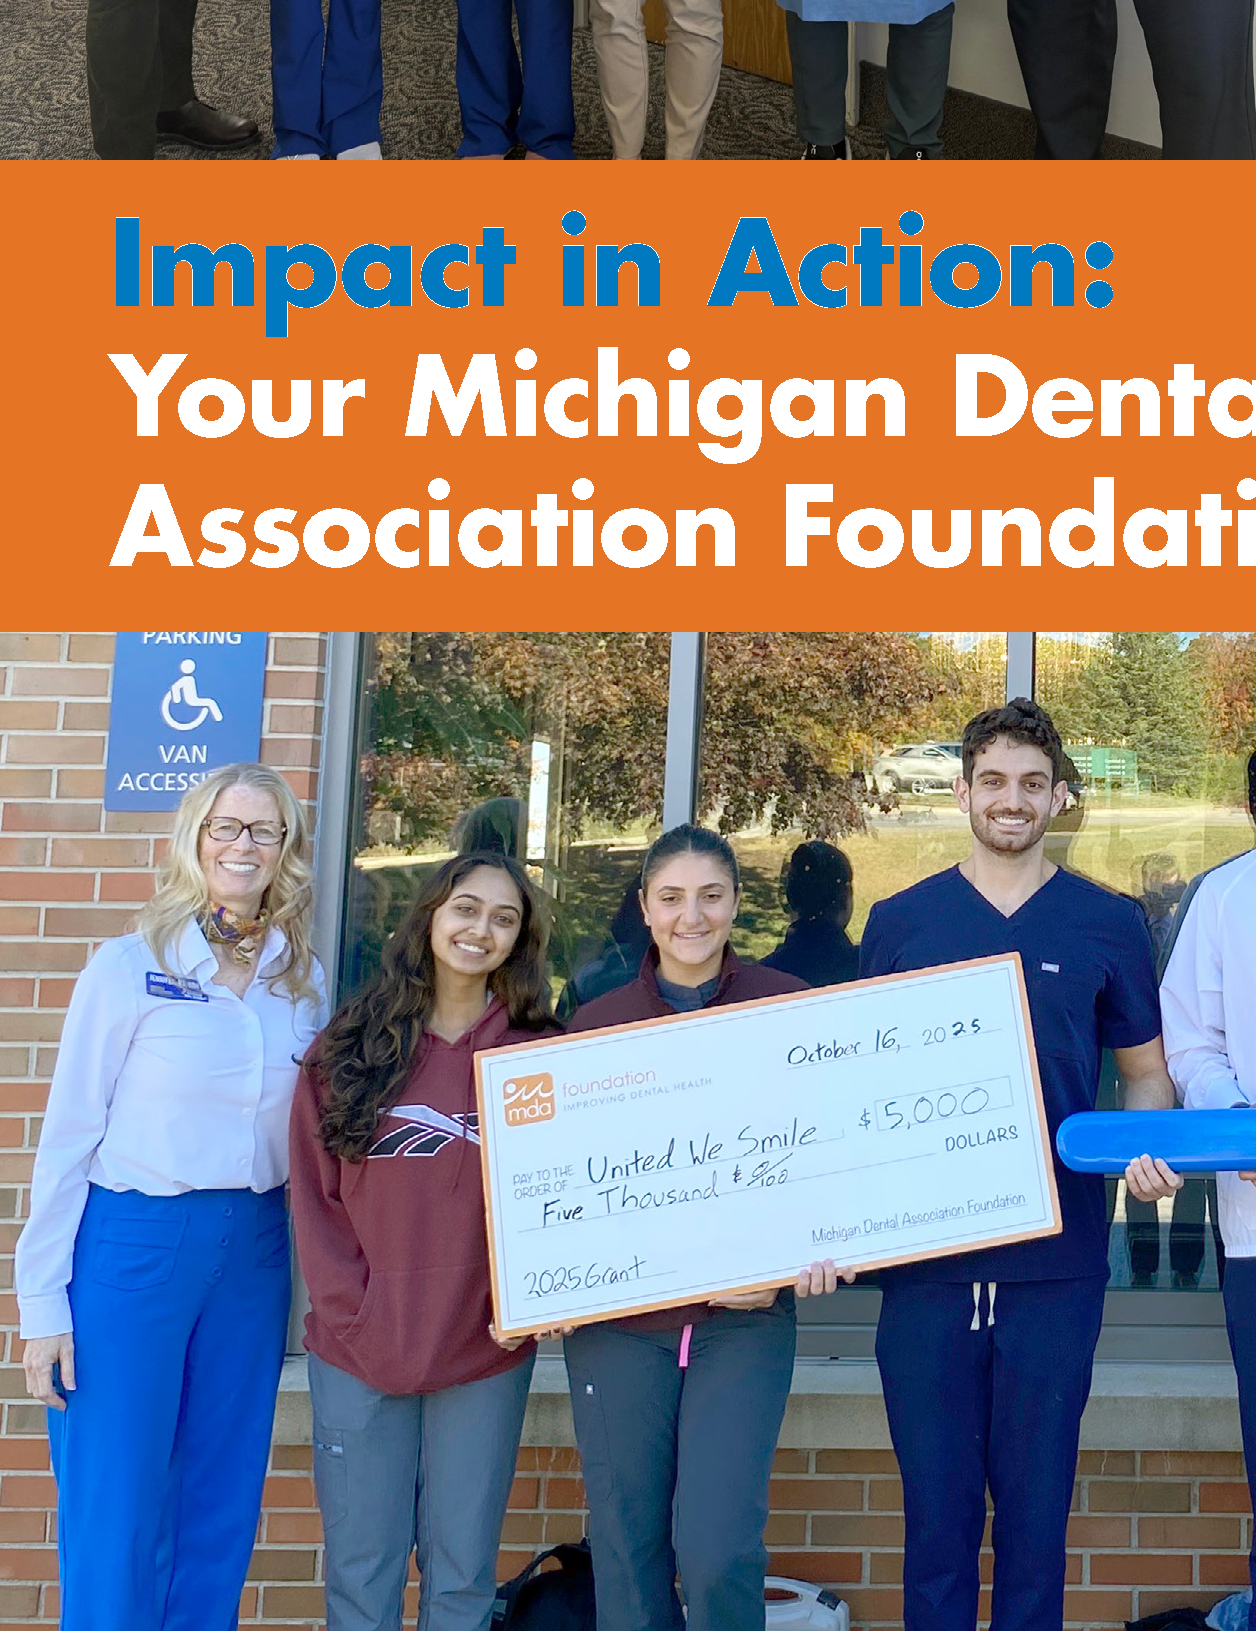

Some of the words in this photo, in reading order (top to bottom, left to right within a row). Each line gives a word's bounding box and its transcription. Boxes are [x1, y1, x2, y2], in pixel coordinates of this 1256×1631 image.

[143, 632, 242, 644] PARKING
[159, 745, 207, 764] VAN
[788, 1039, 860, 1064] October
[876, 1027, 900, 1053] 16,
[563, 1069, 656, 1098] foundation
[563, 1094, 626, 1111] IMPROVING
[630, 1086, 669, 1100] DENTAL
[674, 1077, 712, 1091] HEALTH
[508, 1099, 552, 1121] mda
[859, 1108, 870, 1130] $
[884, 1086, 990, 1130] 5,000
[587, 1137, 675, 1184] United
[690, 1133, 723, 1165] We
[738, 1117, 817, 1156] Smile
[945, 1126, 1018, 1152] DOLLARS
[513, 1172, 533, 1186] PAY
[536, 1170, 551, 1182] TO
[552, 1165, 574, 1178] THE
[515, 1183, 552, 1200] ORDER
[553, 1179, 568, 1192] OF
[543, 1198, 583, 1228] Five
[598, 1170, 719, 1214] Thousand
[812, 1225, 862, 1243] Michigan
[864, 1214, 899, 1234] Dental
[902, 1203, 964, 1226] Association
[966, 1192, 1026, 1214] Foundation
